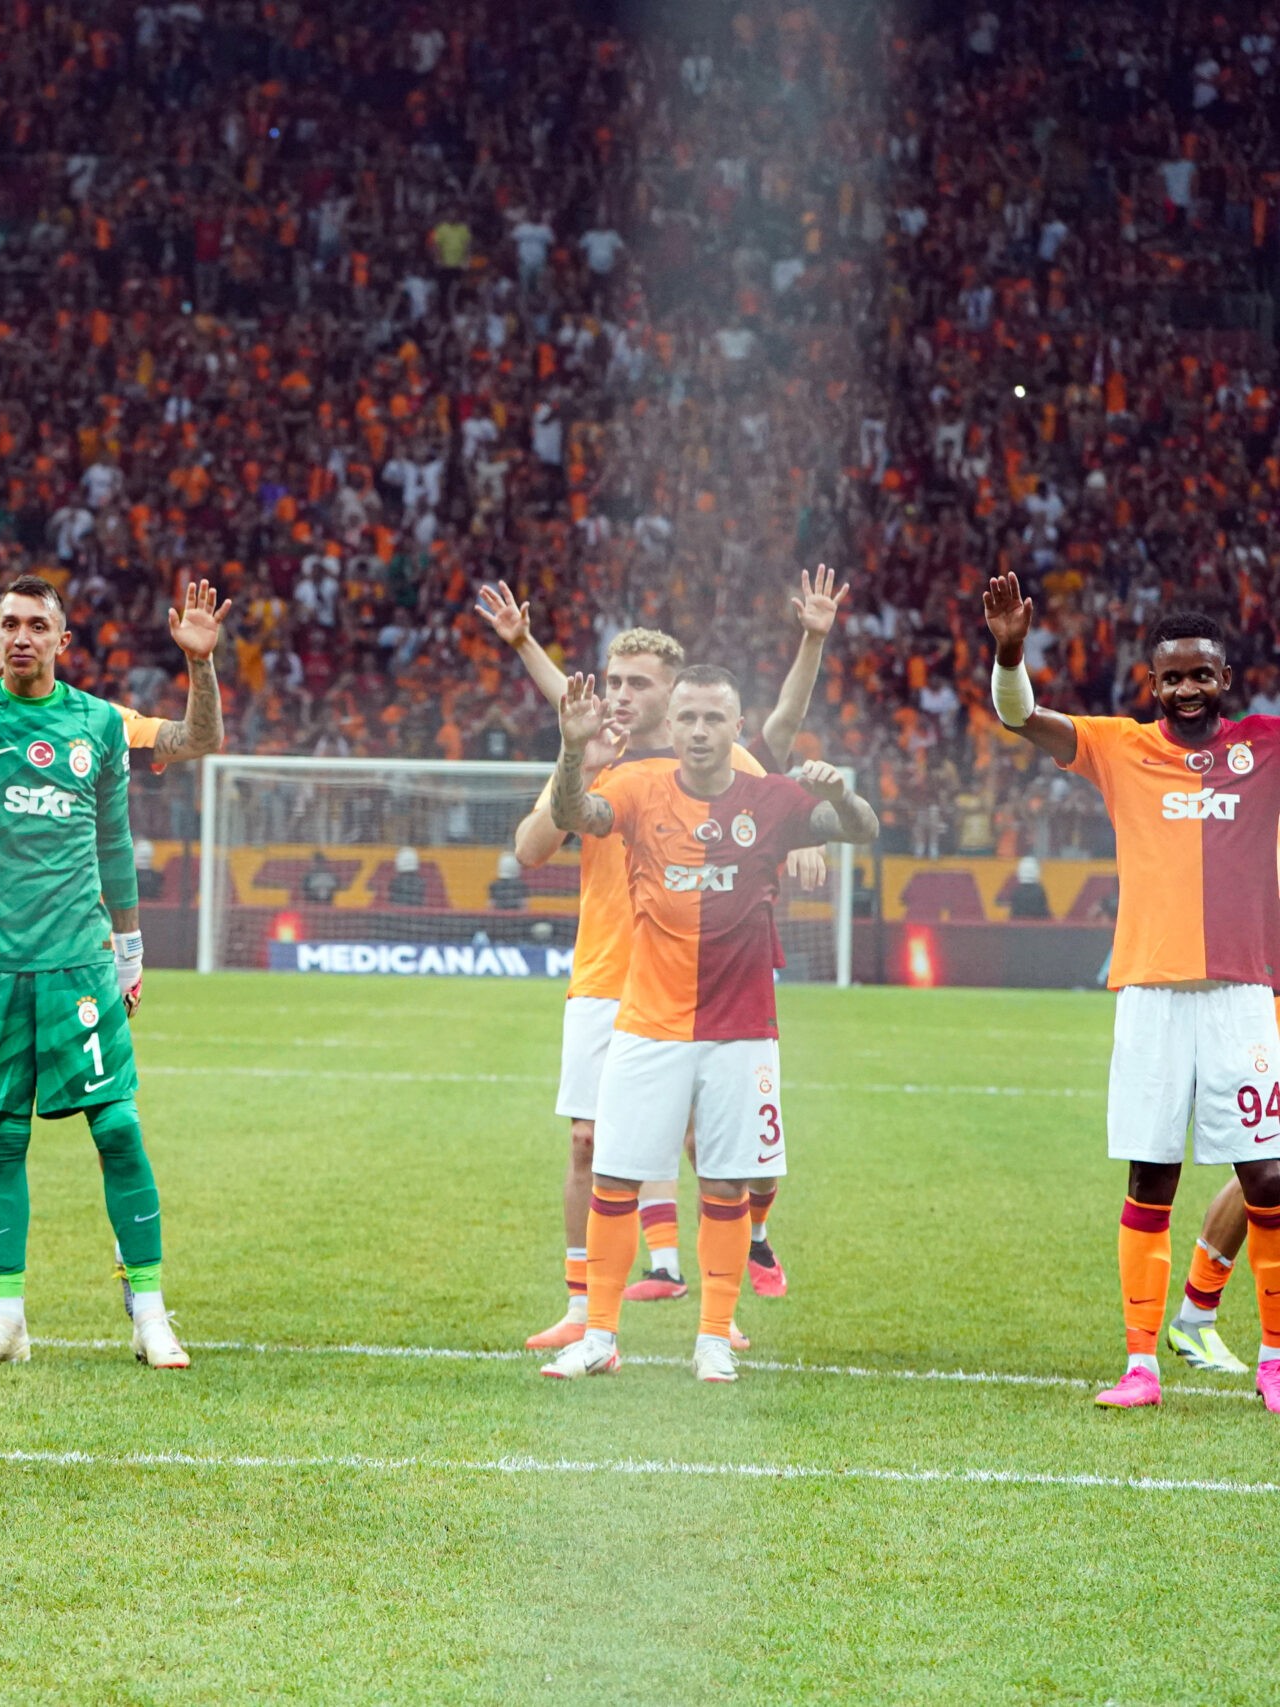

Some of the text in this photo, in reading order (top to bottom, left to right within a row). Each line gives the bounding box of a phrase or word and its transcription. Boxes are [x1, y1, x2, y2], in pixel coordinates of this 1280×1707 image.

[4, 785, 77, 817] SIXT
[1162, 788, 1240, 820] SIXT
[82, 1031, 105, 1077] 1
[758, 1103, 781, 1147] 3
[1237, 1081, 1280, 1129] 94
